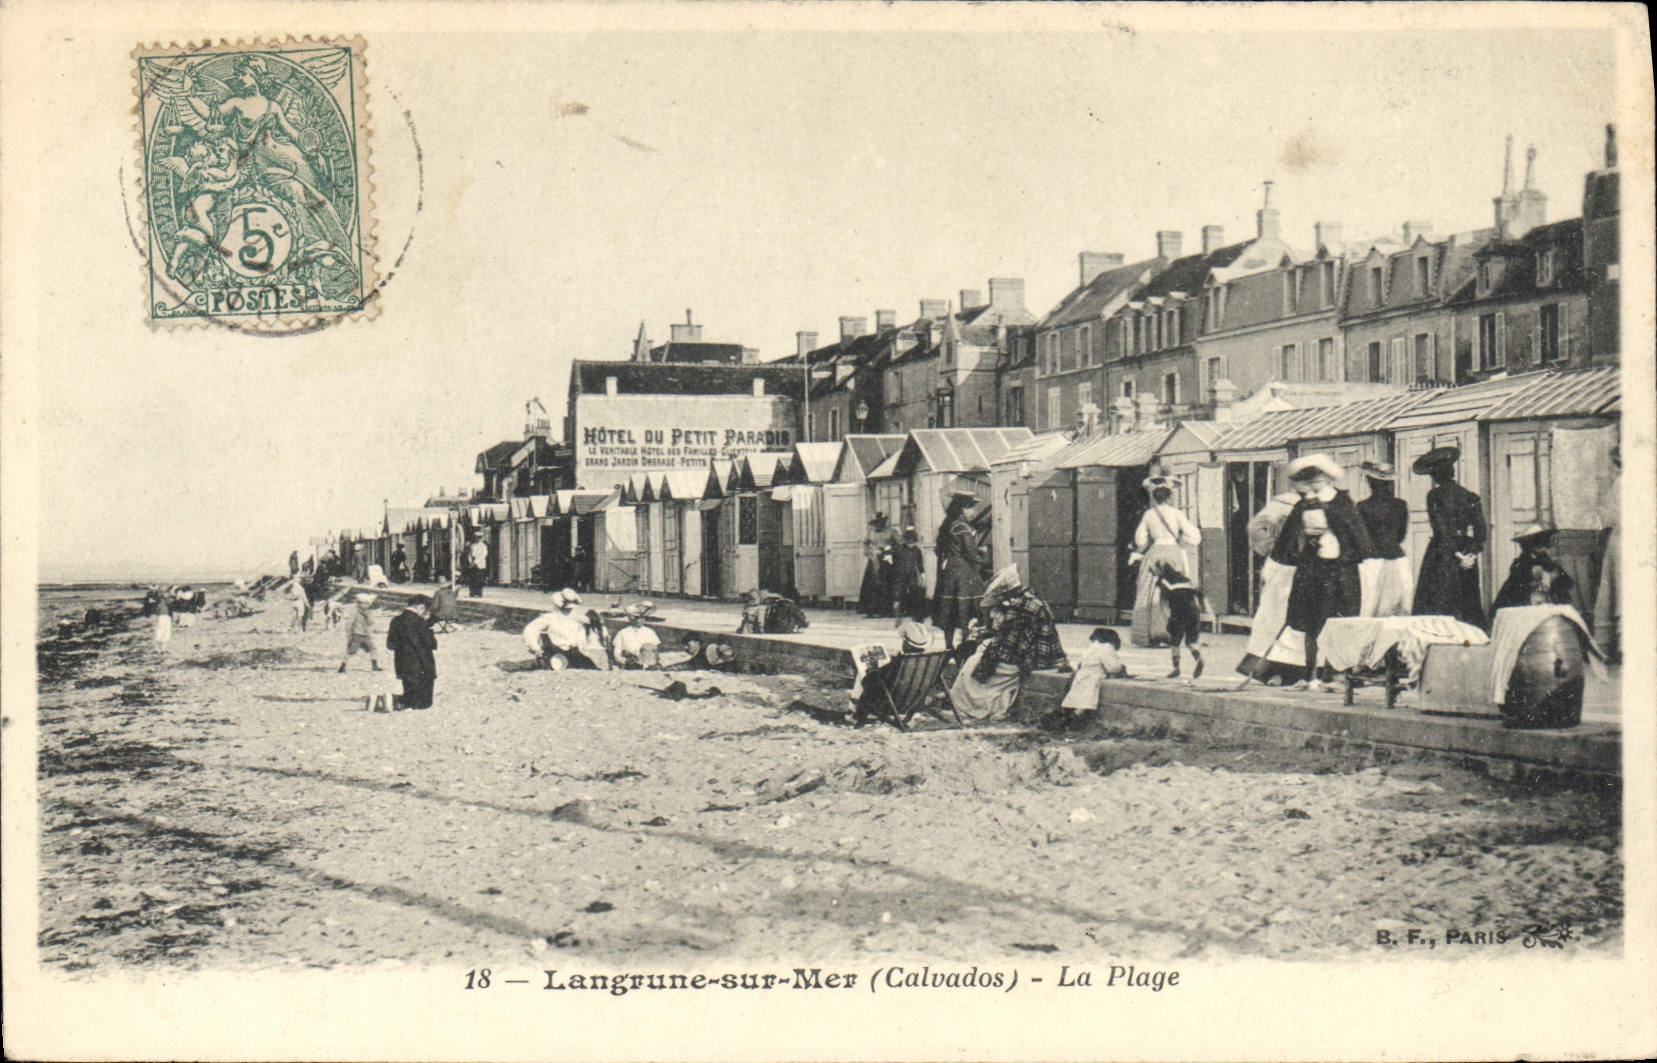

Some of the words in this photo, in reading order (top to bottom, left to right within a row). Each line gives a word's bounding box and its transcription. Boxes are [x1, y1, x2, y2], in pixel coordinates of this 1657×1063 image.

[211, 287, 302, 313] POSTES
[584, 426, 637, 446] HÔTEL
[645, 429, 664, 444] DU
[671, 428, 718, 446] PETIT
[723, 429, 790, 446] PARADIS
[588, 447, 597, 455] LE
[611, 456, 639, 467] JARDIN
